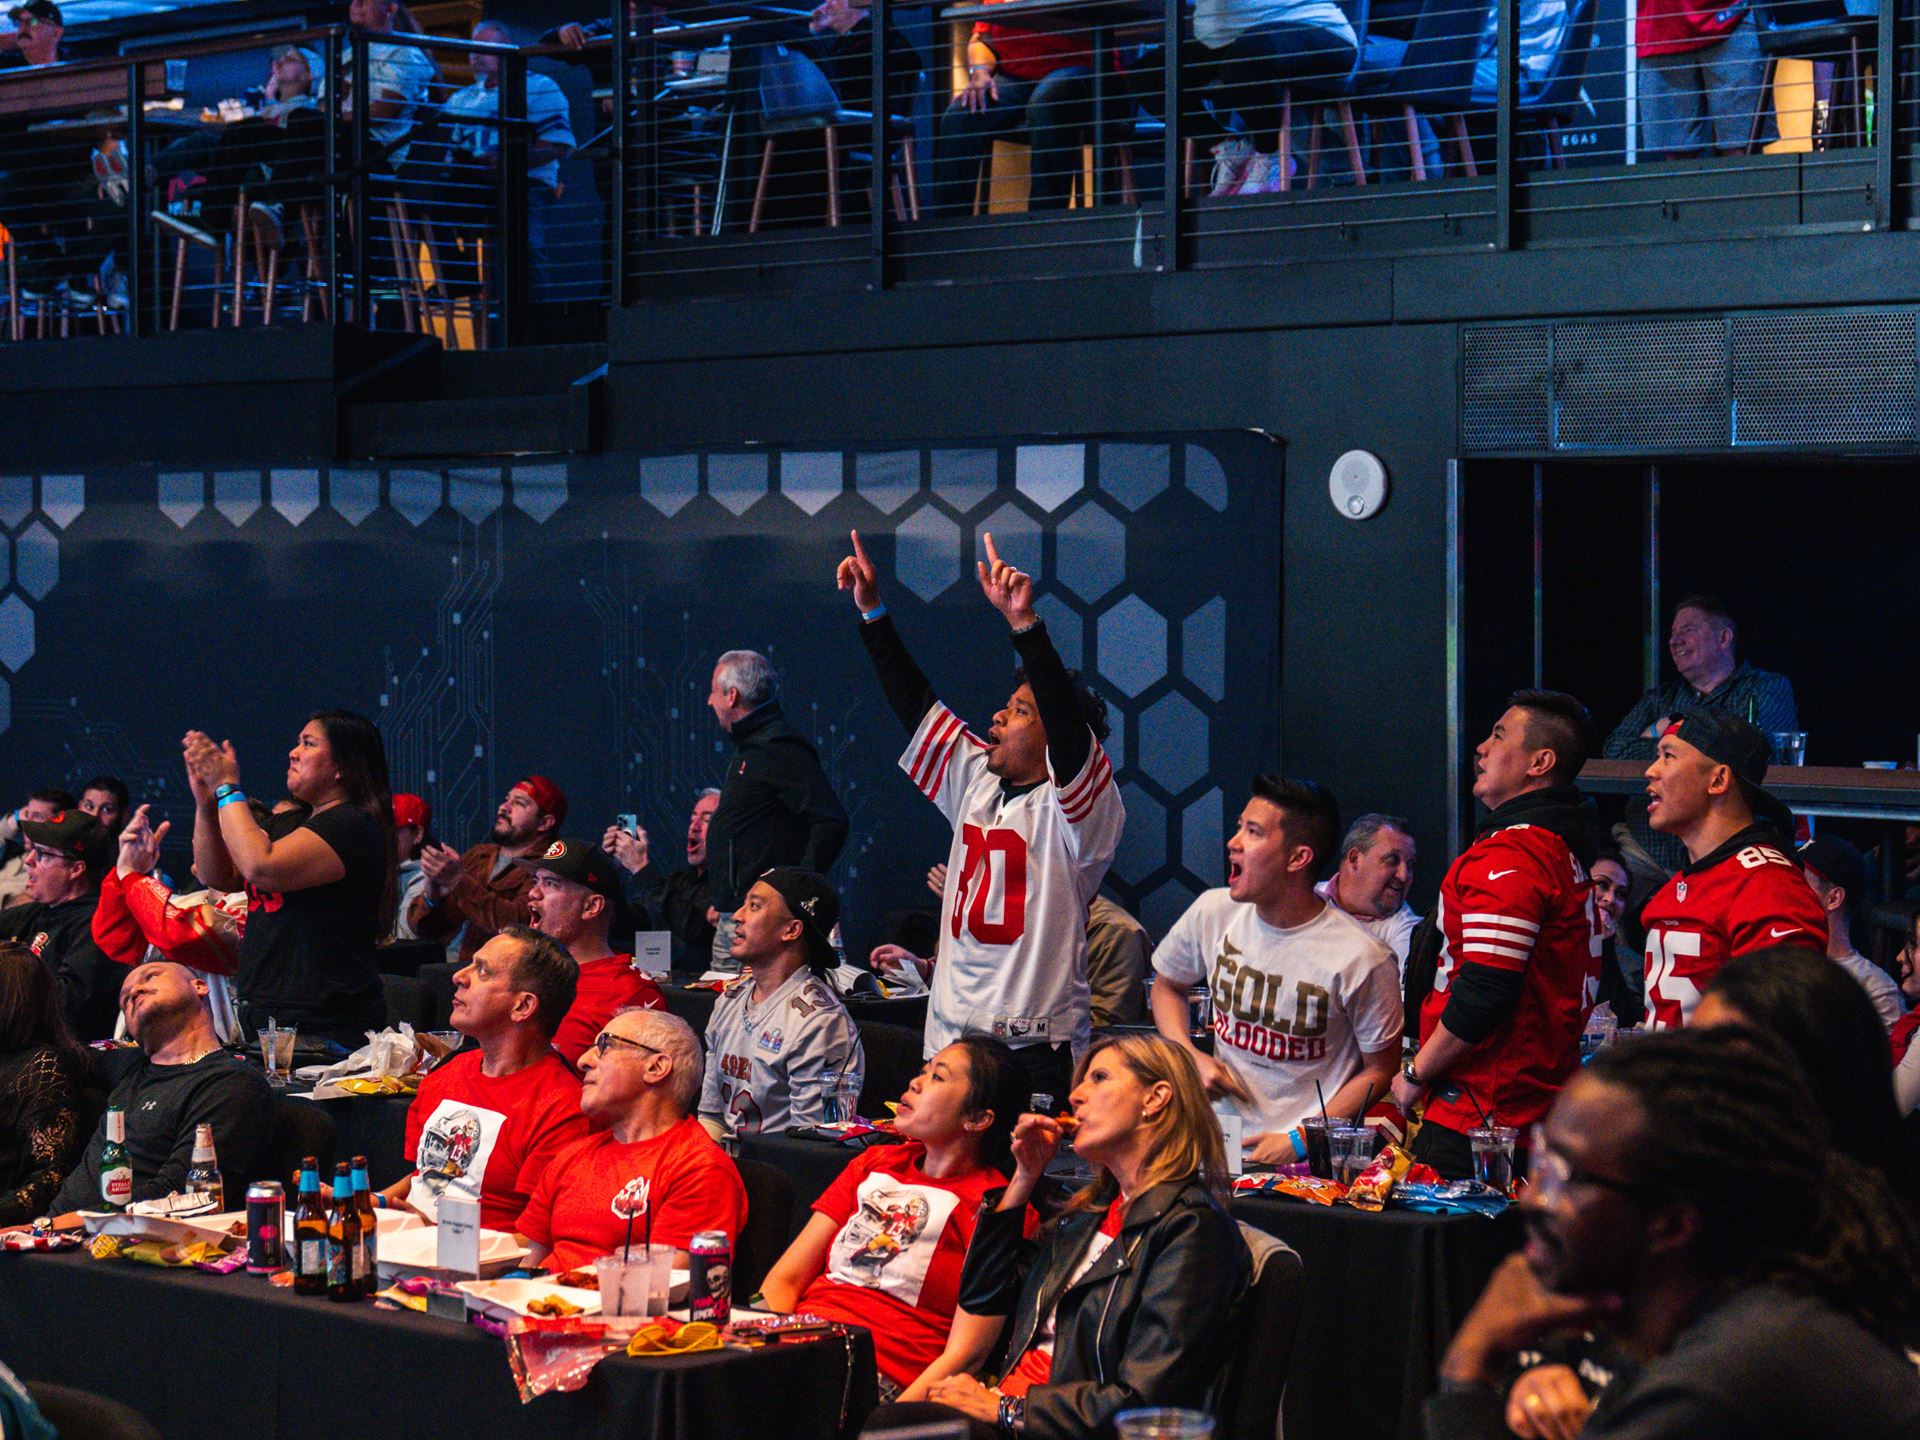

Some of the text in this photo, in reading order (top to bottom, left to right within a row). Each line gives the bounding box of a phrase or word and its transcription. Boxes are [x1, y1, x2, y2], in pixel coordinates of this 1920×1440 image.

[1736, 847, 1793, 869] 85
[791, 984, 835, 1018] 13
[1211, 954, 1329, 1038] GOLD
[1037, 1023, 1045, 1032] M
[1214, 1007, 1326, 1061] BLOODED
